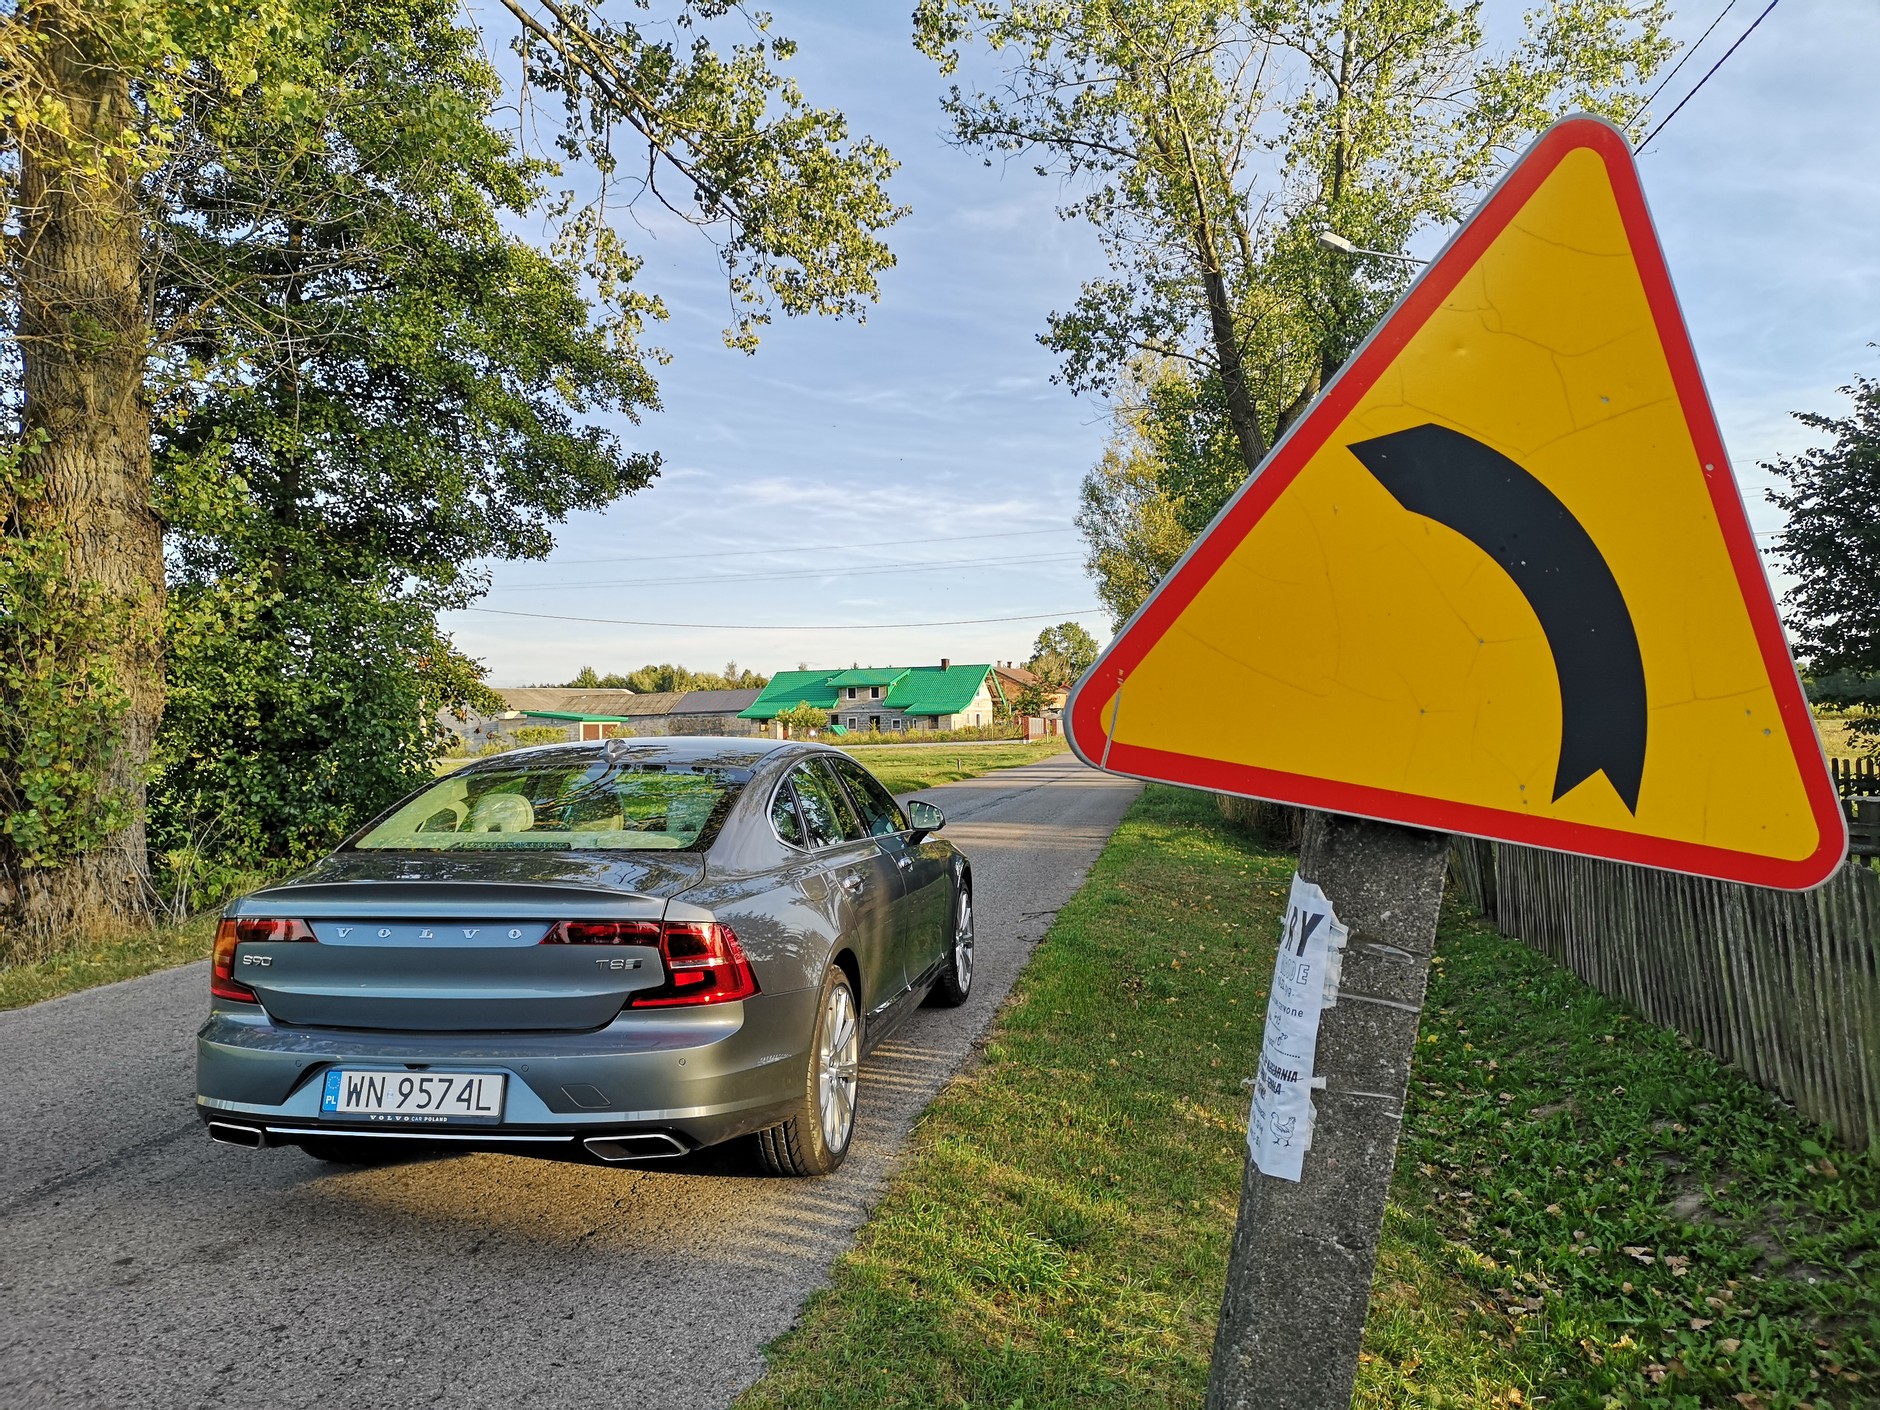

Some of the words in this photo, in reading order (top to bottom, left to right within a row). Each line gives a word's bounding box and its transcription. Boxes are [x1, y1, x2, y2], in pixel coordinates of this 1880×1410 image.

[336, 927, 522, 939] VOLVO
[242, 955, 272, 966] S90
[346, 1076, 386, 1108] WN
[396, 1078, 491, 1111] 9574L
[325, 1096, 337, 1105] PL
